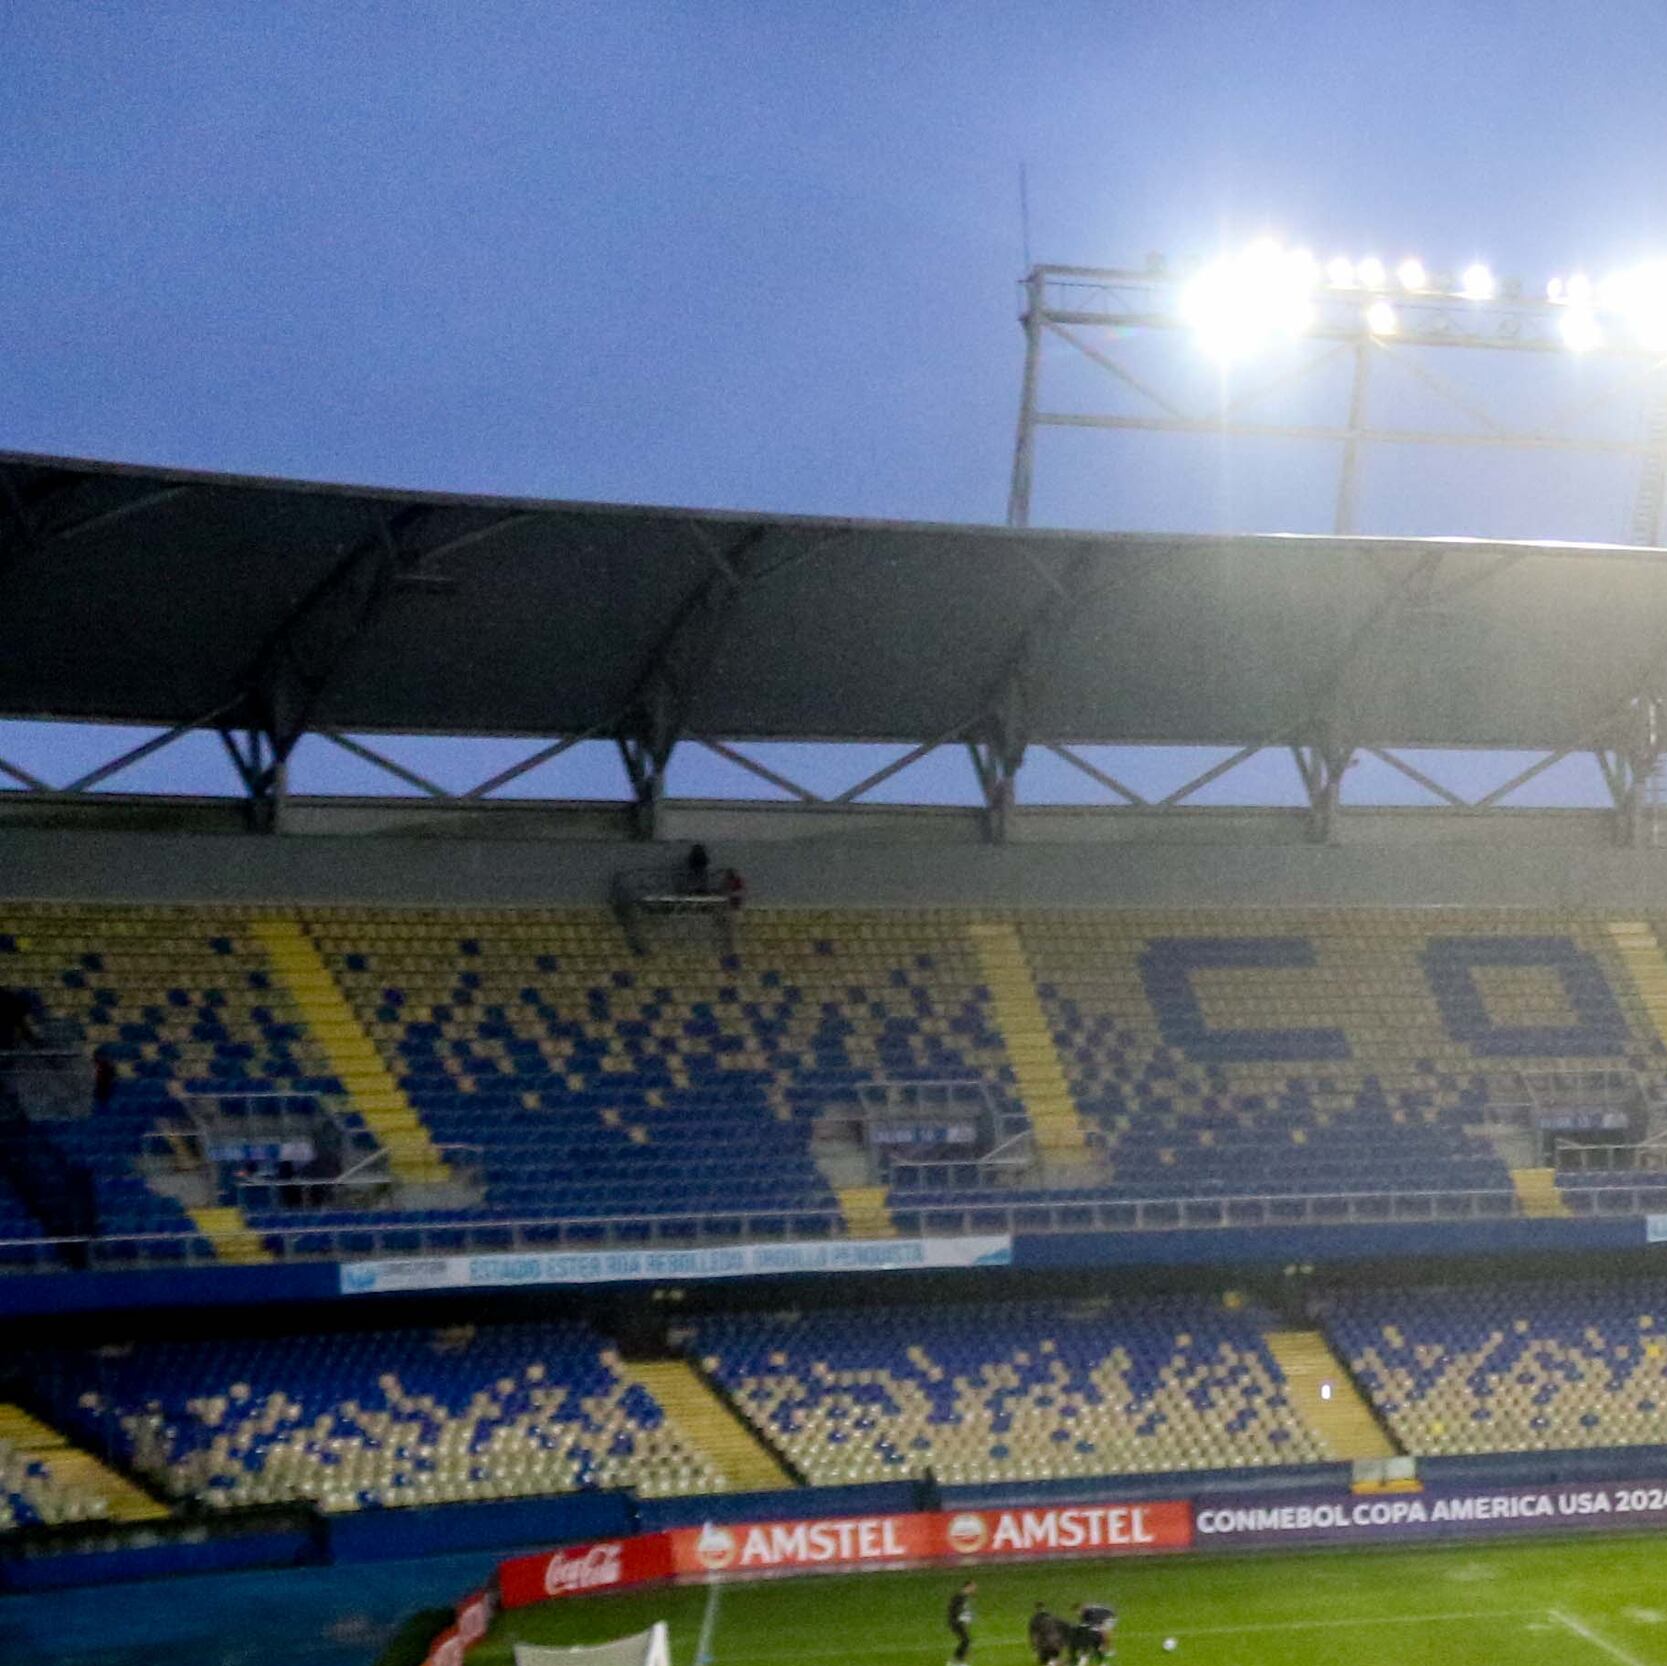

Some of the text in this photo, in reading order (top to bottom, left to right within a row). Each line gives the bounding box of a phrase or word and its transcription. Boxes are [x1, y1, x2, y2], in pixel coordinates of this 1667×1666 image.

[991, 1507, 1156, 1550] AMSTEL
[1197, 1504, 1352, 1534] CONMEBOL
[1353, 1500, 1424, 1526] COPA
[1431, 1494, 1553, 1522] AMERICA
[1558, 1491, 1610, 1515] USA
[739, 1519, 907, 1566] AMSTEL
